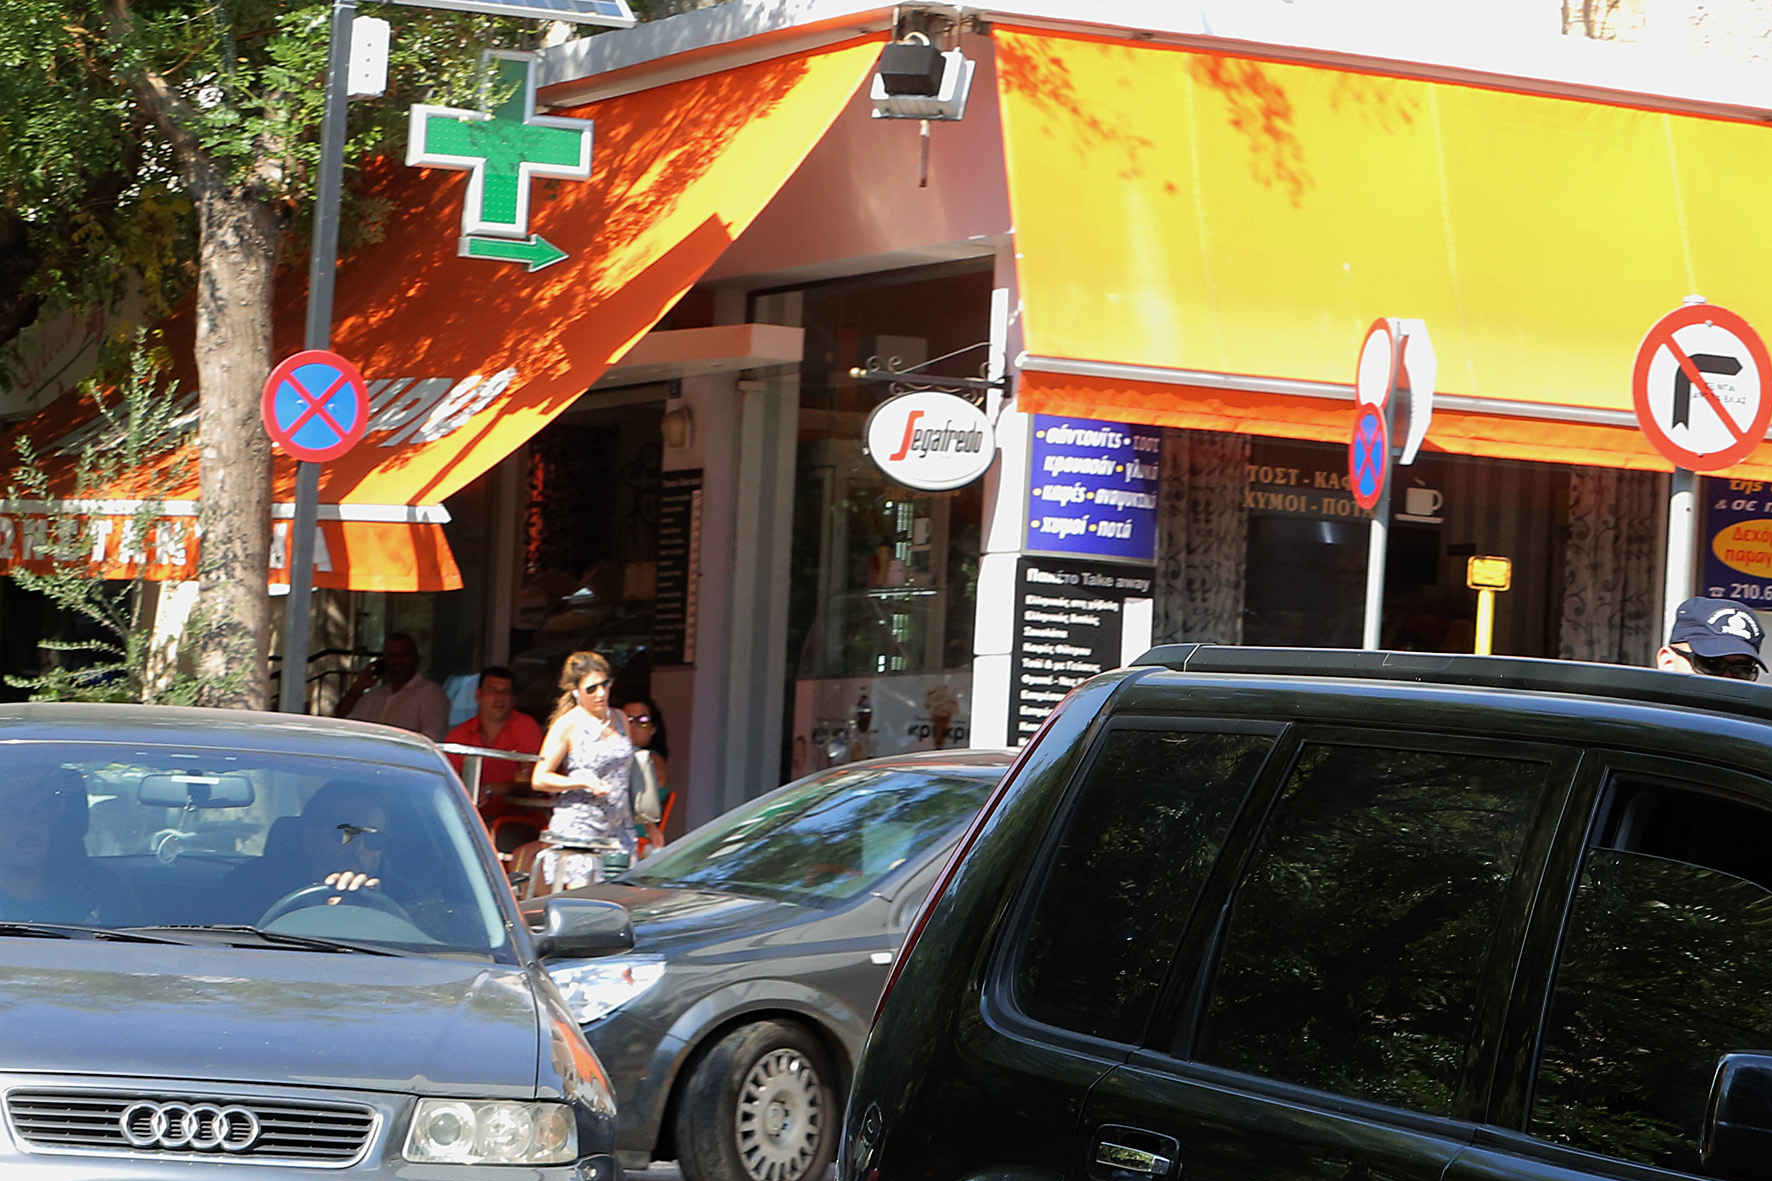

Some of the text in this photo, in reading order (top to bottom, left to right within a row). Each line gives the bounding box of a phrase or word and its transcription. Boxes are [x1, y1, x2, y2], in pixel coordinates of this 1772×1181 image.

[888, 410, 984, 461] Segafredo
[1731, 499, 1758, 511] σε
[1097, 519, 1133, 539] ποτά
[1081, 571, 1114, 588] Take
[1115, 578, 1151, 593] away
